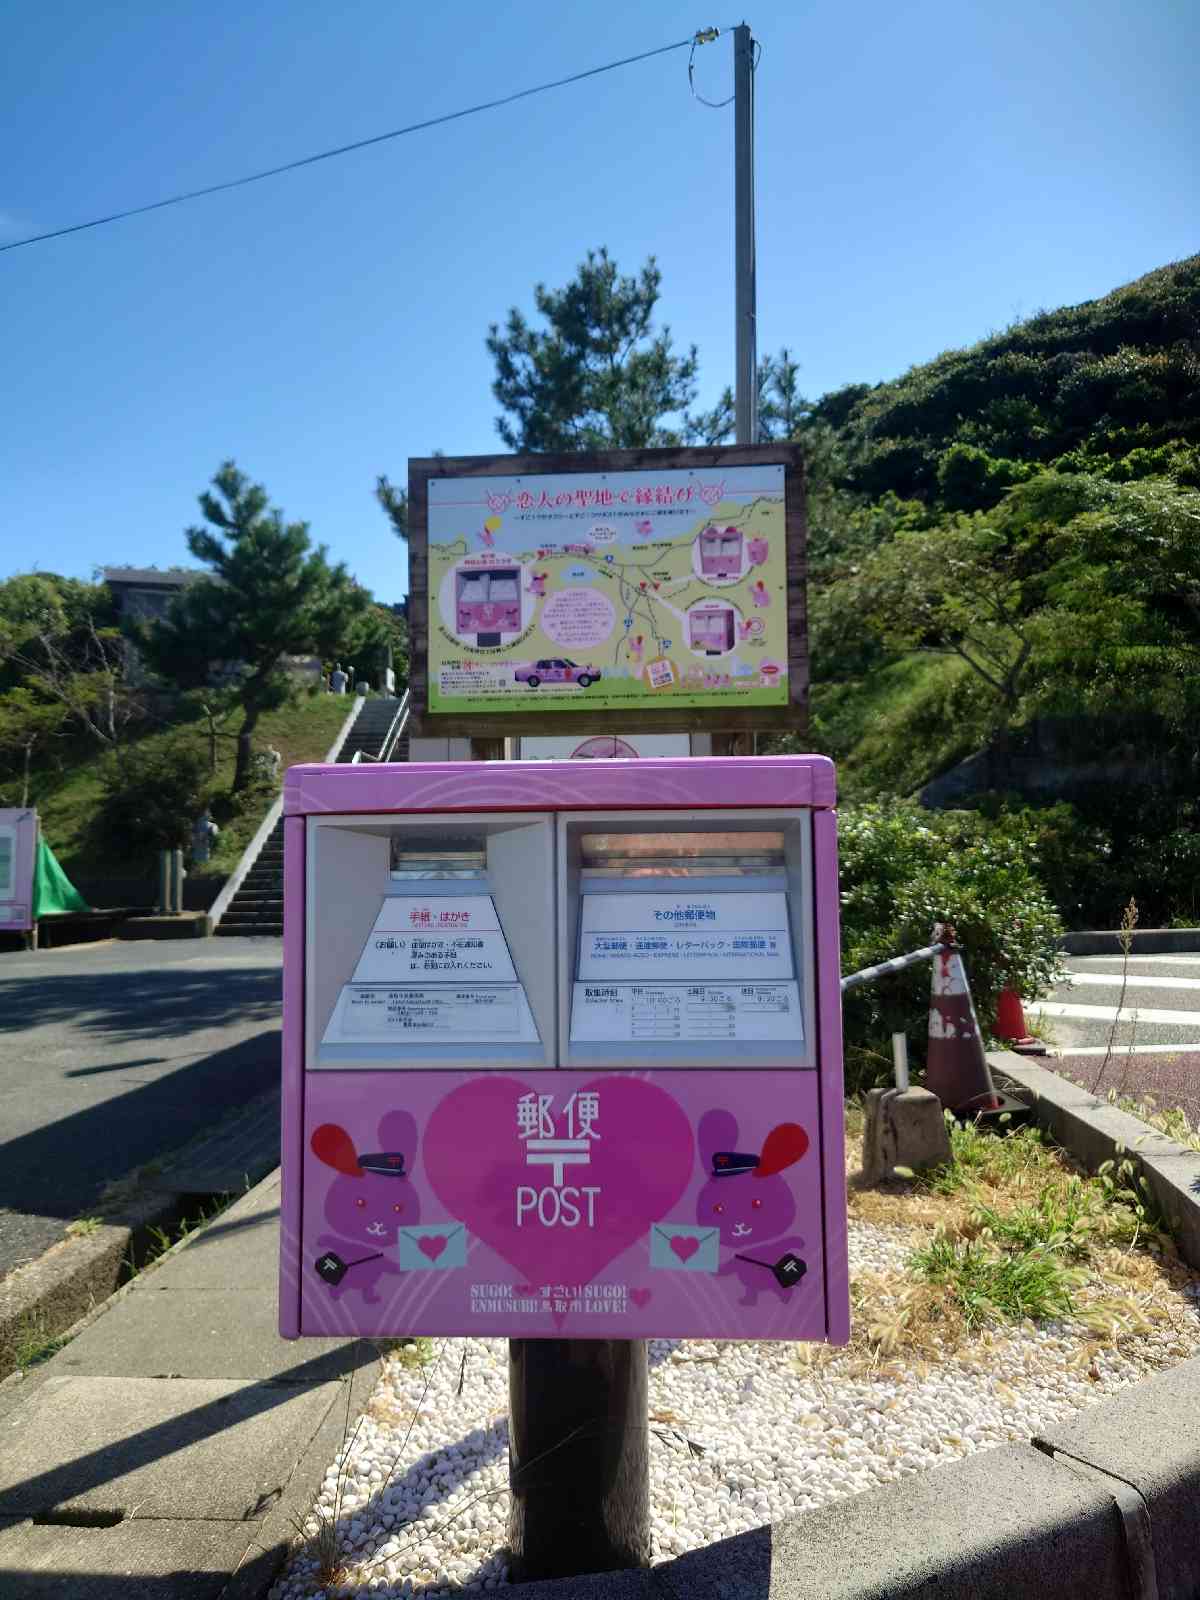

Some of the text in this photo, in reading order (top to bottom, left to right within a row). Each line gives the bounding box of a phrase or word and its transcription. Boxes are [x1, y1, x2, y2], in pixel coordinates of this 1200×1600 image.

[653, 910, 716, 921] その他郵便物
[516, 1092, 602, 1139] 郵便
[516, 1186, 602, 1227] POST
[585, 1284, 628, 1298] SUGO!
[585, 1299, 627, 1313] LOVE!
